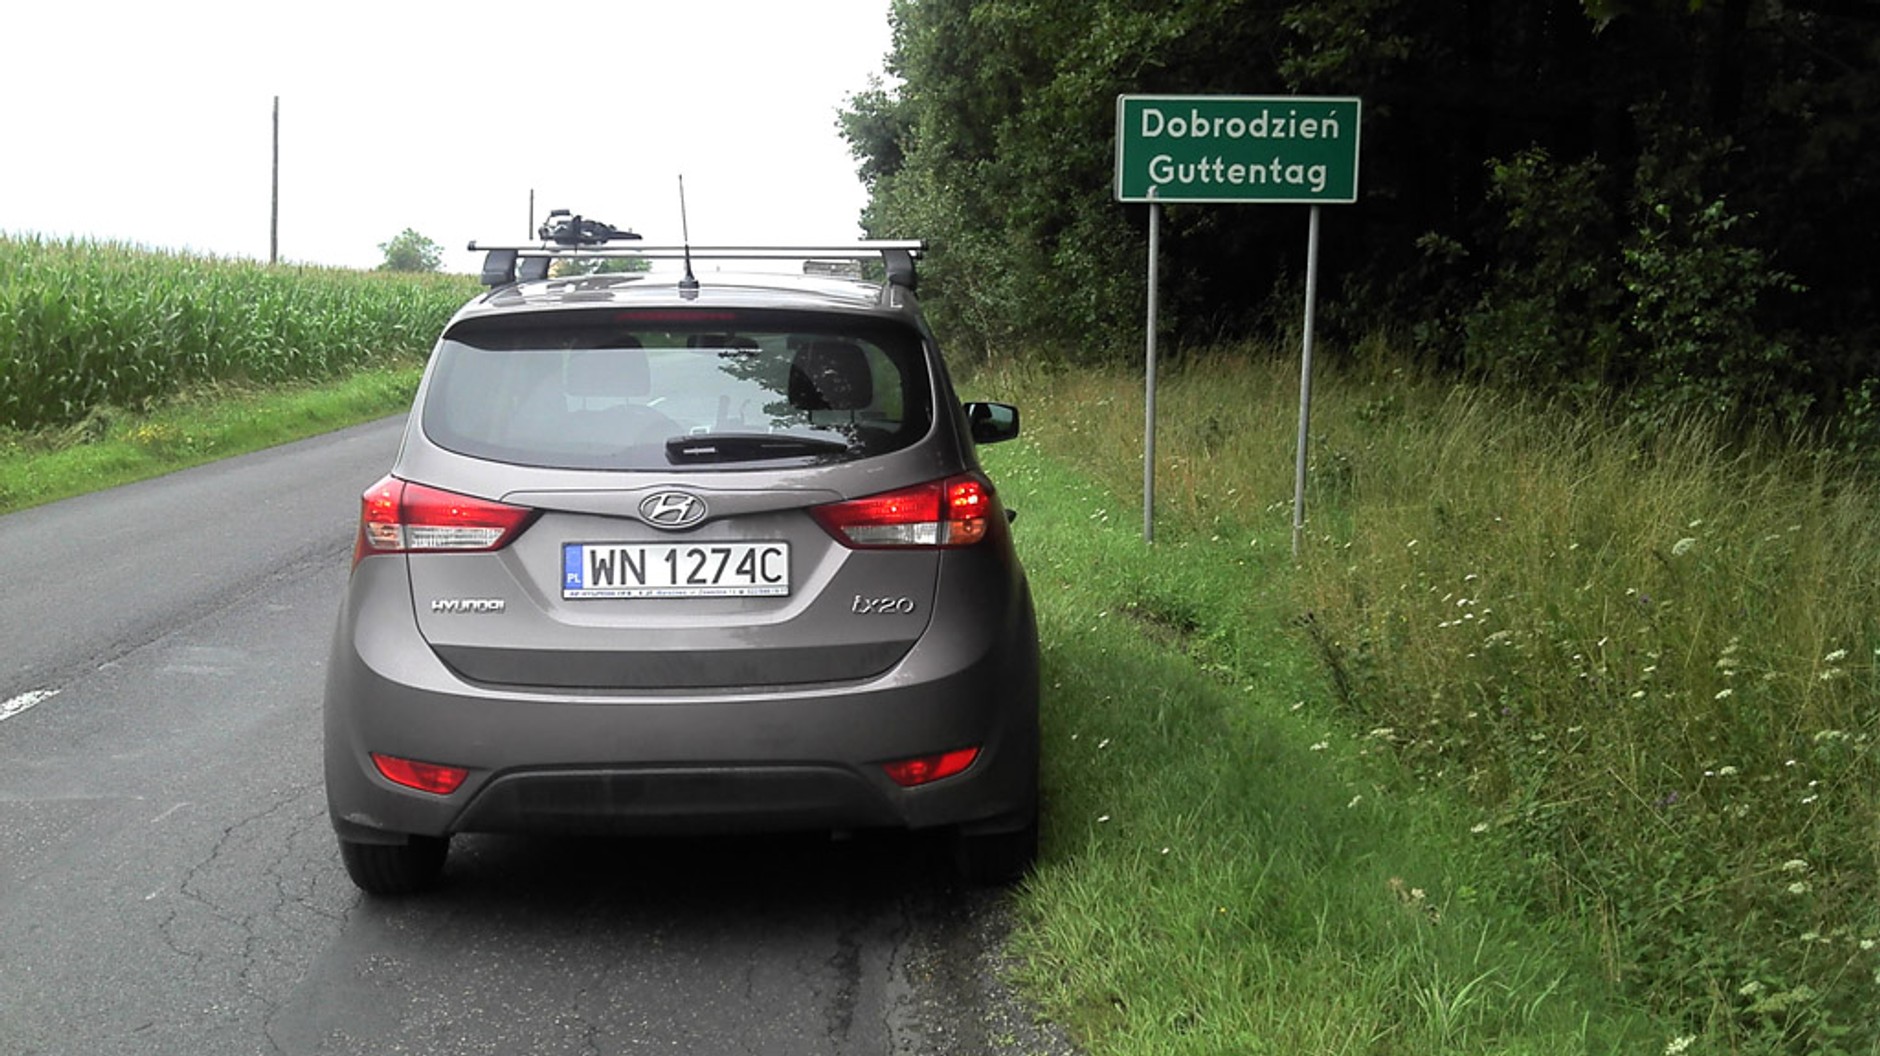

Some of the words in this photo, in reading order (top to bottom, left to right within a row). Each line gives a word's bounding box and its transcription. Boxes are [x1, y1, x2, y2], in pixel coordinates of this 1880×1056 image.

[1141, 108, 1339, 139] Dobrodzień
[1148, 154, 1327, 193] Guttentag
[567, 573, 581, 584] PL
[590, 549, 646, 586] WN
[664, 547, 782, 585] 1274C
[431, 599, 505, 613] HYUNDAI
[851, 594, 915, 614] ix20
